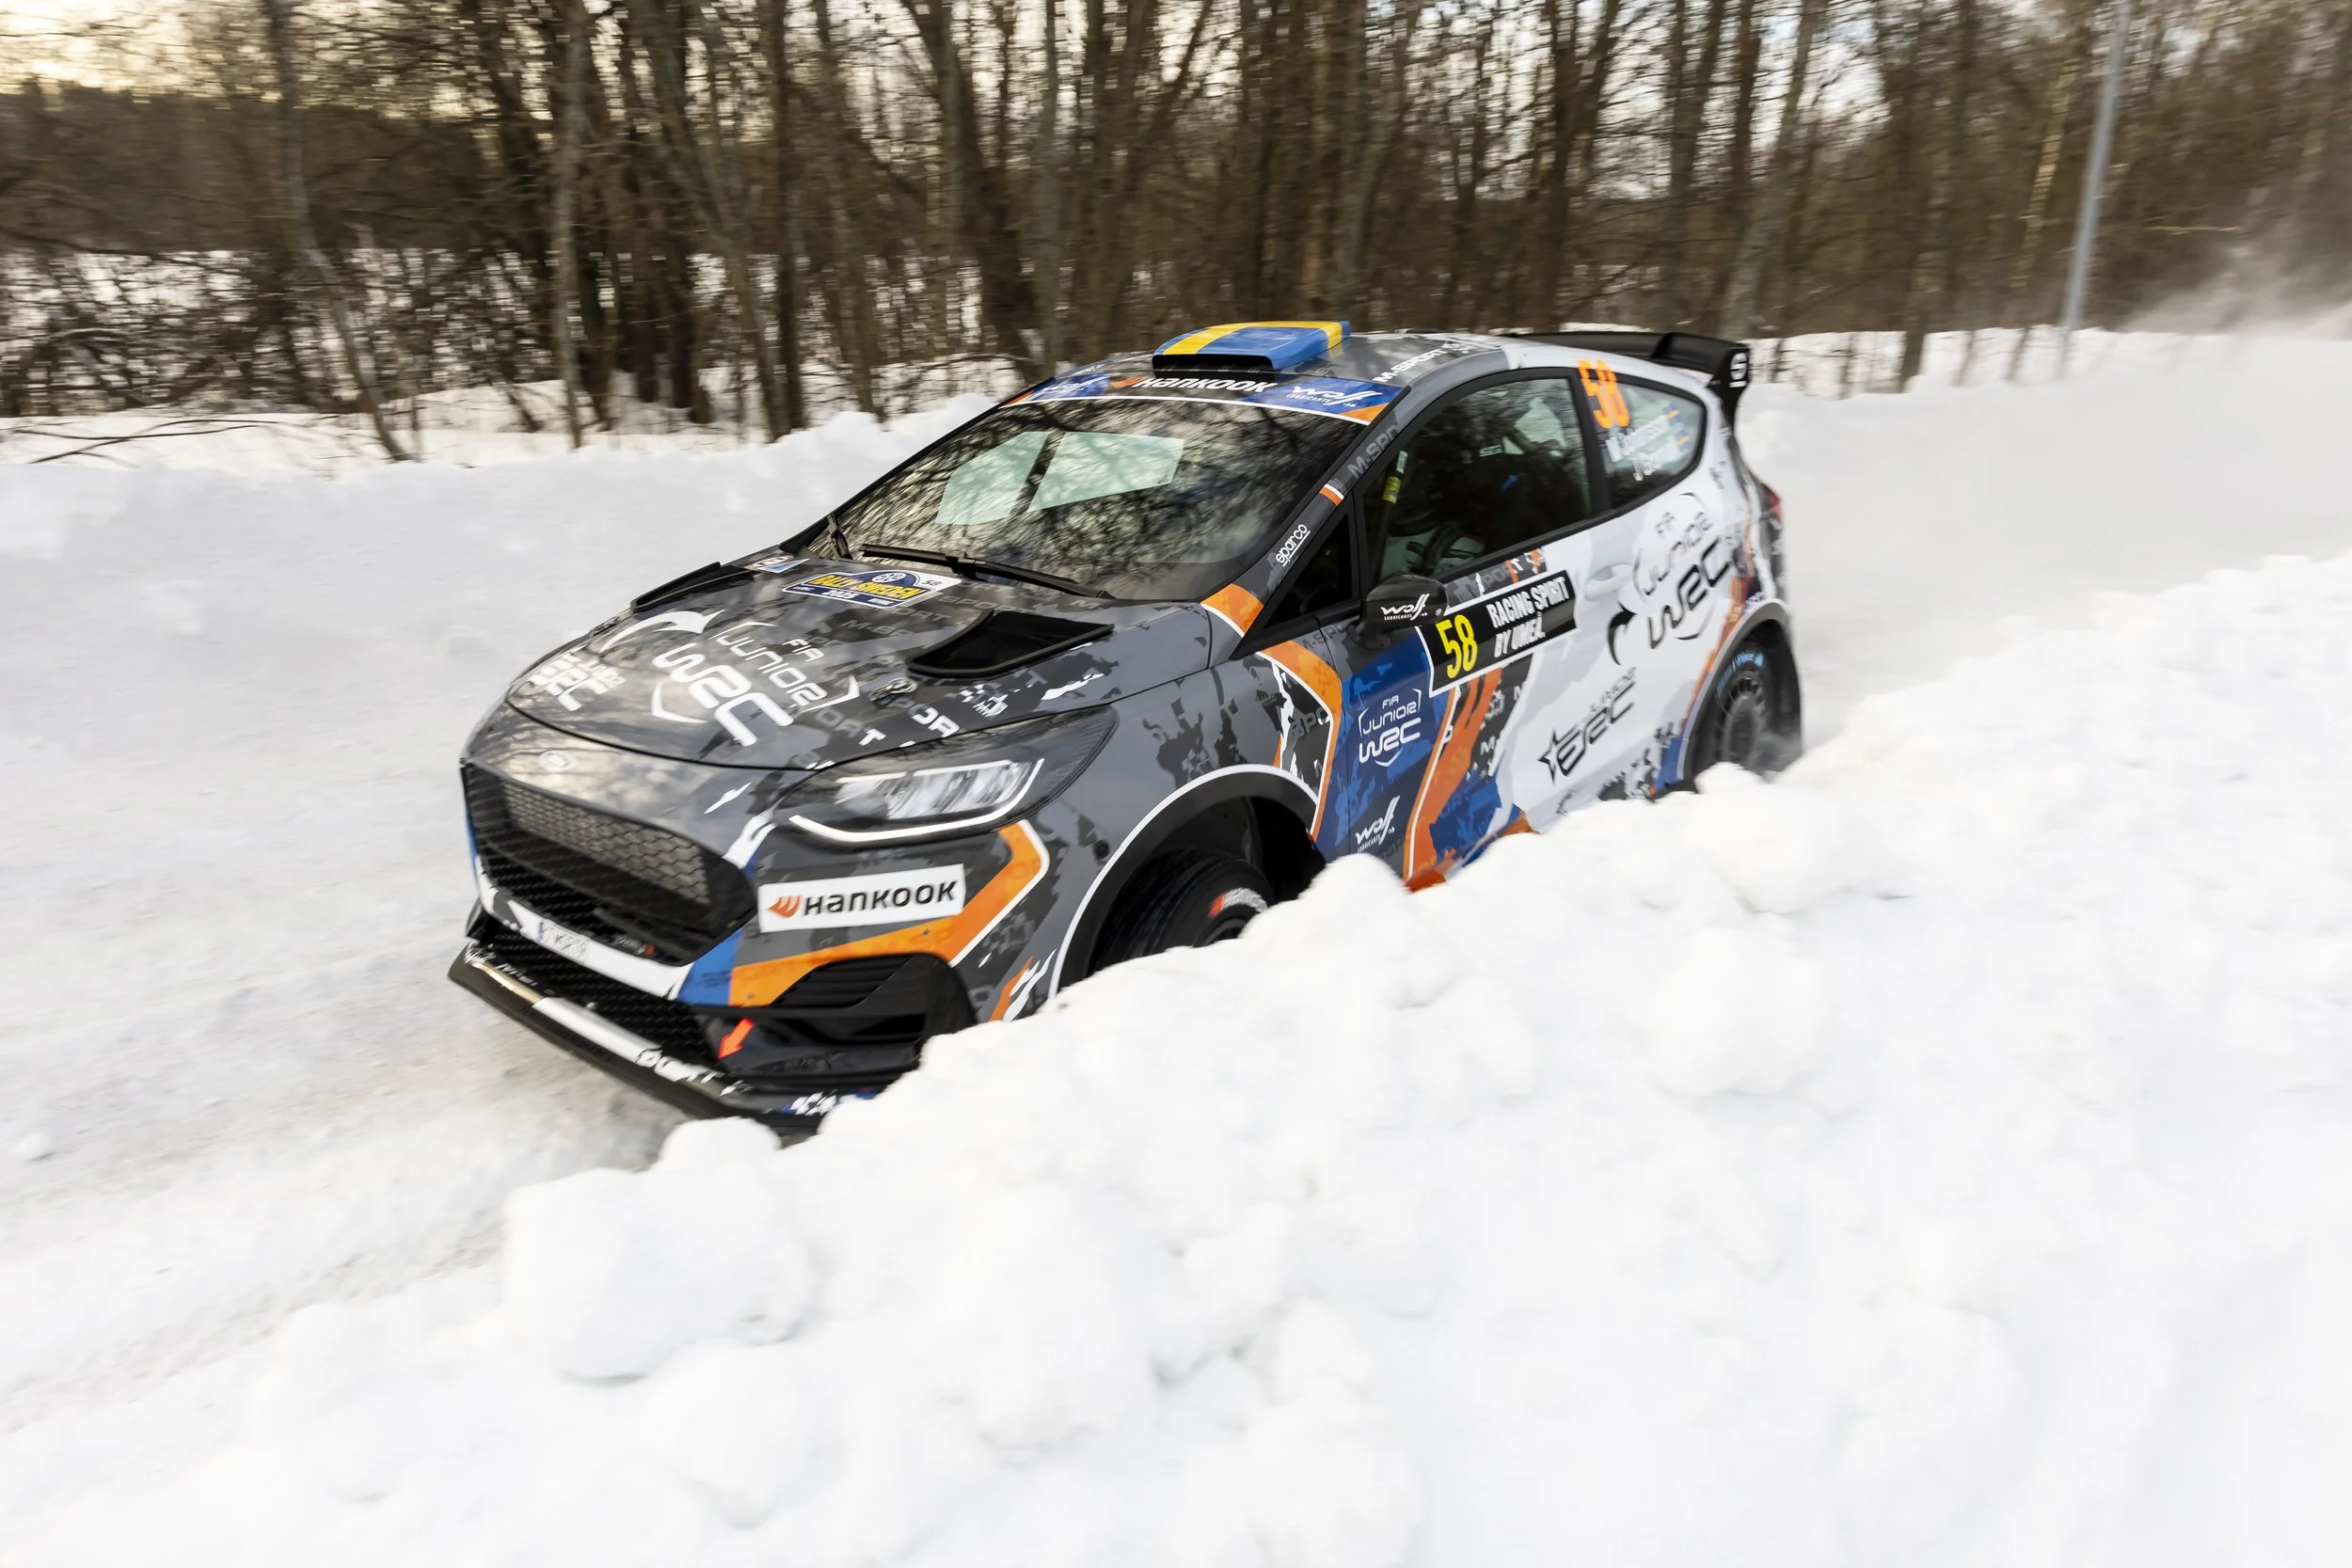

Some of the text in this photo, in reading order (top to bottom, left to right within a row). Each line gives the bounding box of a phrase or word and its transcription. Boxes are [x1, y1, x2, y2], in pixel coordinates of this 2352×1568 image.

[1373, 347, 1447, 383] M-SPORT
[1579, 359, 1629, 429] 58
[1276, 524, 1309, 564] sparco
[1486, 577, 1569, 628] RACING SPIRIT
[782, 638, 825, 662] FIA
[1436, 614, 1478, 678] 58
[652, 642, 794, 747] WRC
[1383, 694, 1399, 709] FIA
[1363, 703, 1417, 735] JUNIOR
[1359, 717, 1421, 764] WRC
[803, 881, 956, 916] HANKOOK
